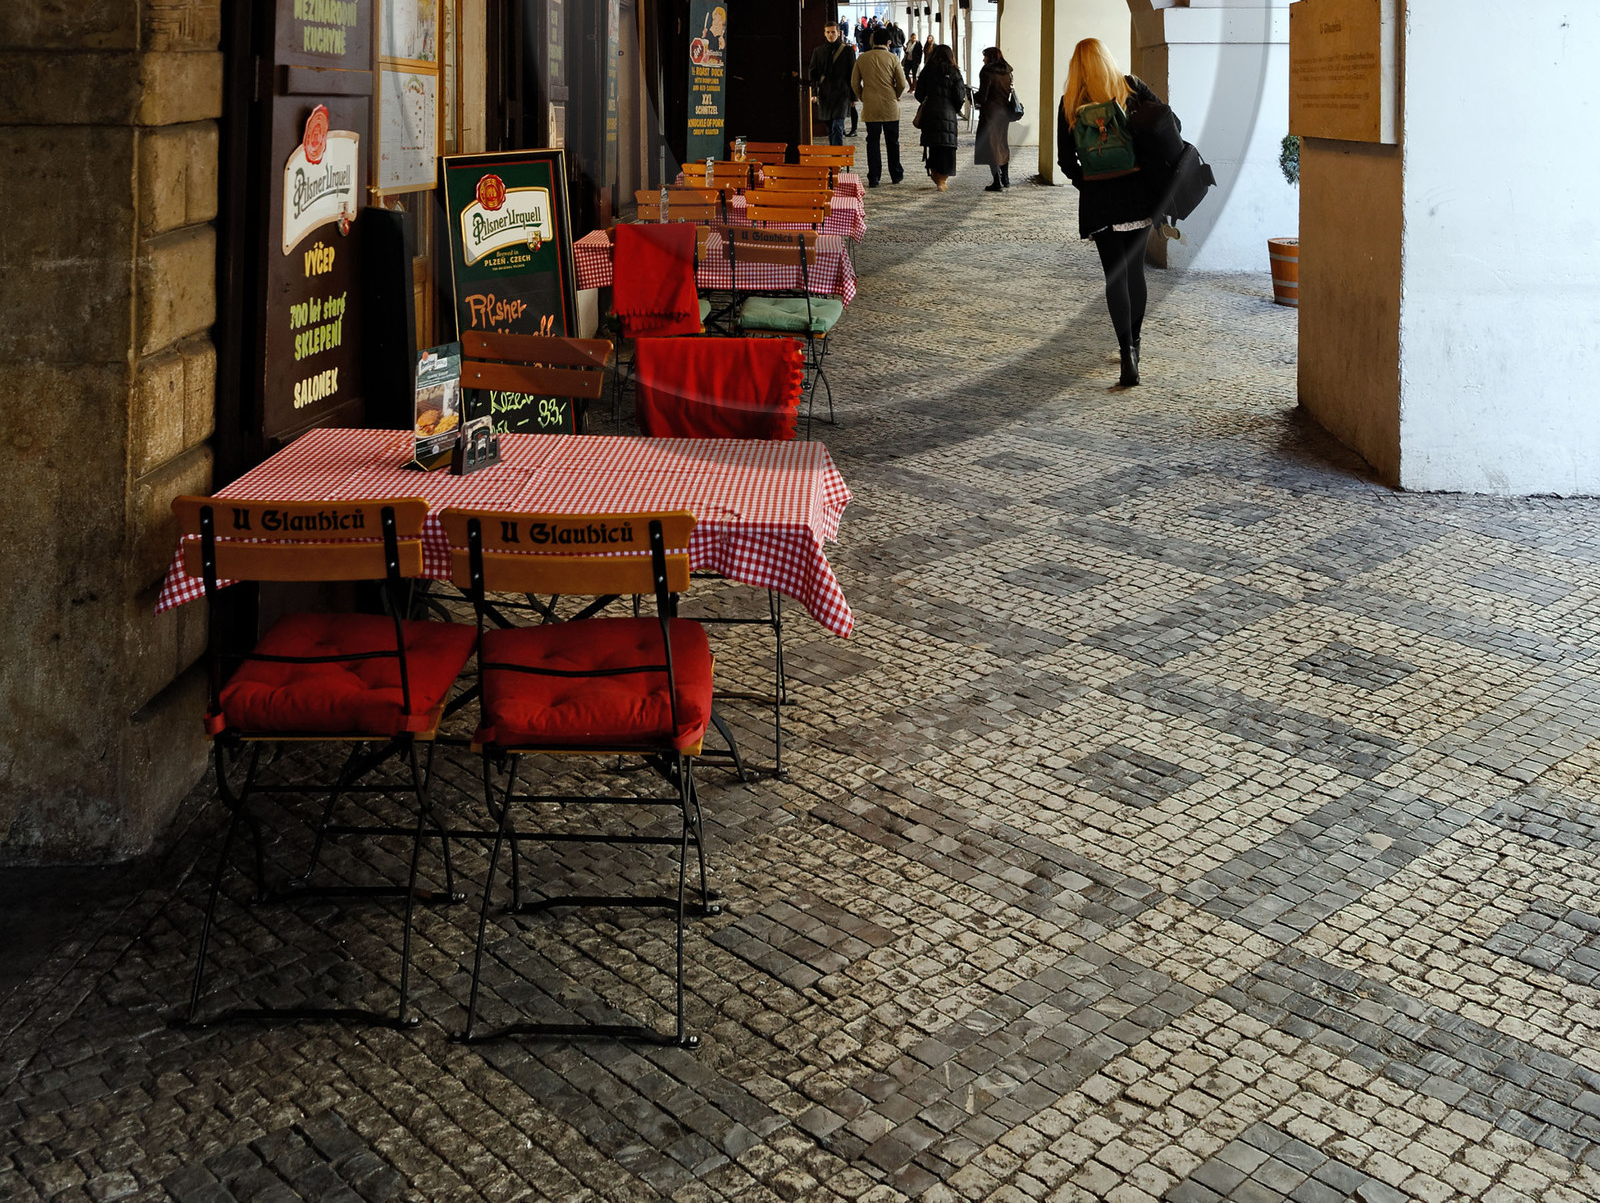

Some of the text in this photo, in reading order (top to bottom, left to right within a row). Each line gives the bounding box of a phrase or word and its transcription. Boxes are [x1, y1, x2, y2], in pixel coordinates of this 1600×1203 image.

[702, 94, 712, 105] XXL
[293, 162, 351, 219] Pilsner Urquell
[472, 206, 541, 246] Pilsner Urquell
[304, 241, 336, 278] VÝČEP
[484, 254, 531, 267] PLZEŇ CZECH
[309, 297, 321, 324] let
[323, 291, 347, 320] staré
[464, 293, 527, 329] Pilsner
[294, 314, 343, 361] SKLEPENÍ
[293, 367, 339, 410] SALONEK
[232, 508, 365, 532] U Glaubiců
[501, 521, 634, 544] U Glaubiců
